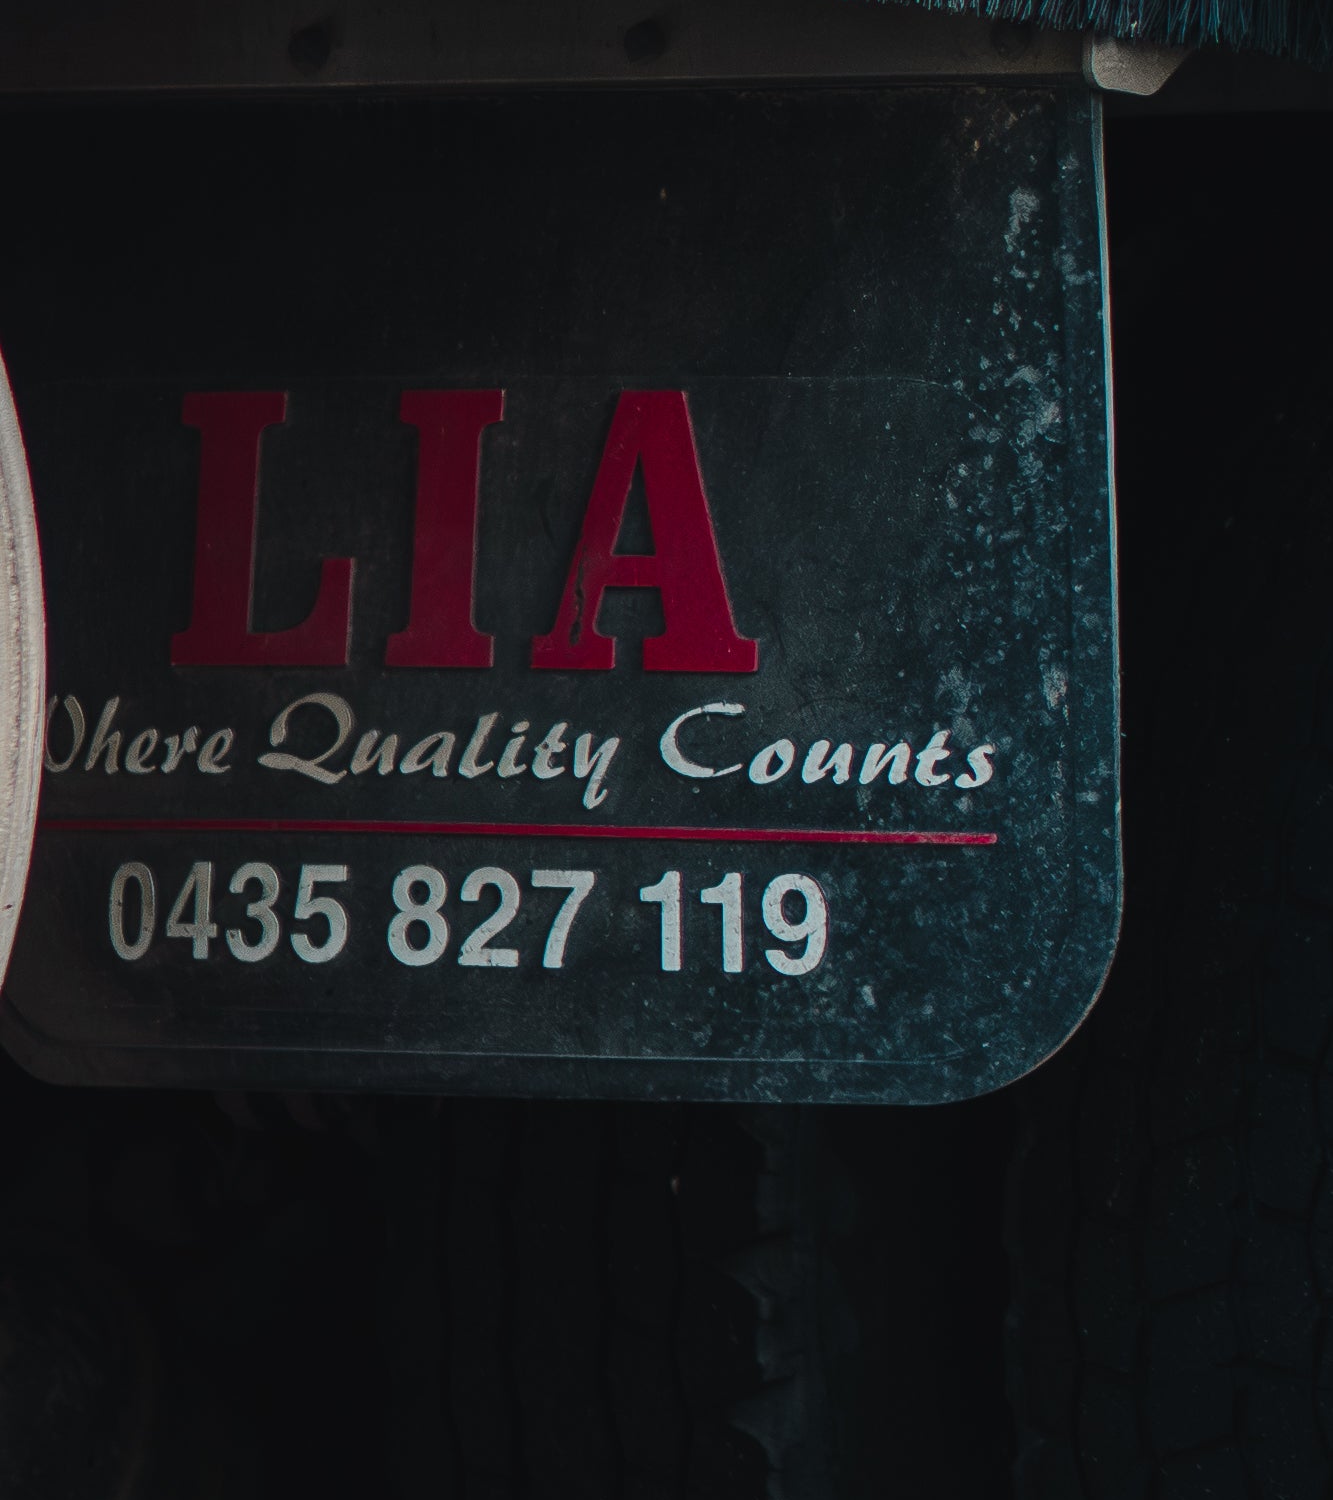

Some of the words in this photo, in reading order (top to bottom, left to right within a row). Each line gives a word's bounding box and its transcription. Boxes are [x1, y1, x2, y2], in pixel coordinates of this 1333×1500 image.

[171, 388, 758, 673] LIA
[258, 692, 620, 810] Quality
[660, 702, 996, 789] Counts
[109, 861, 350, 964] 0435
[388, 866, 595, 968] 827
[640, 870, 829, 976] 119
